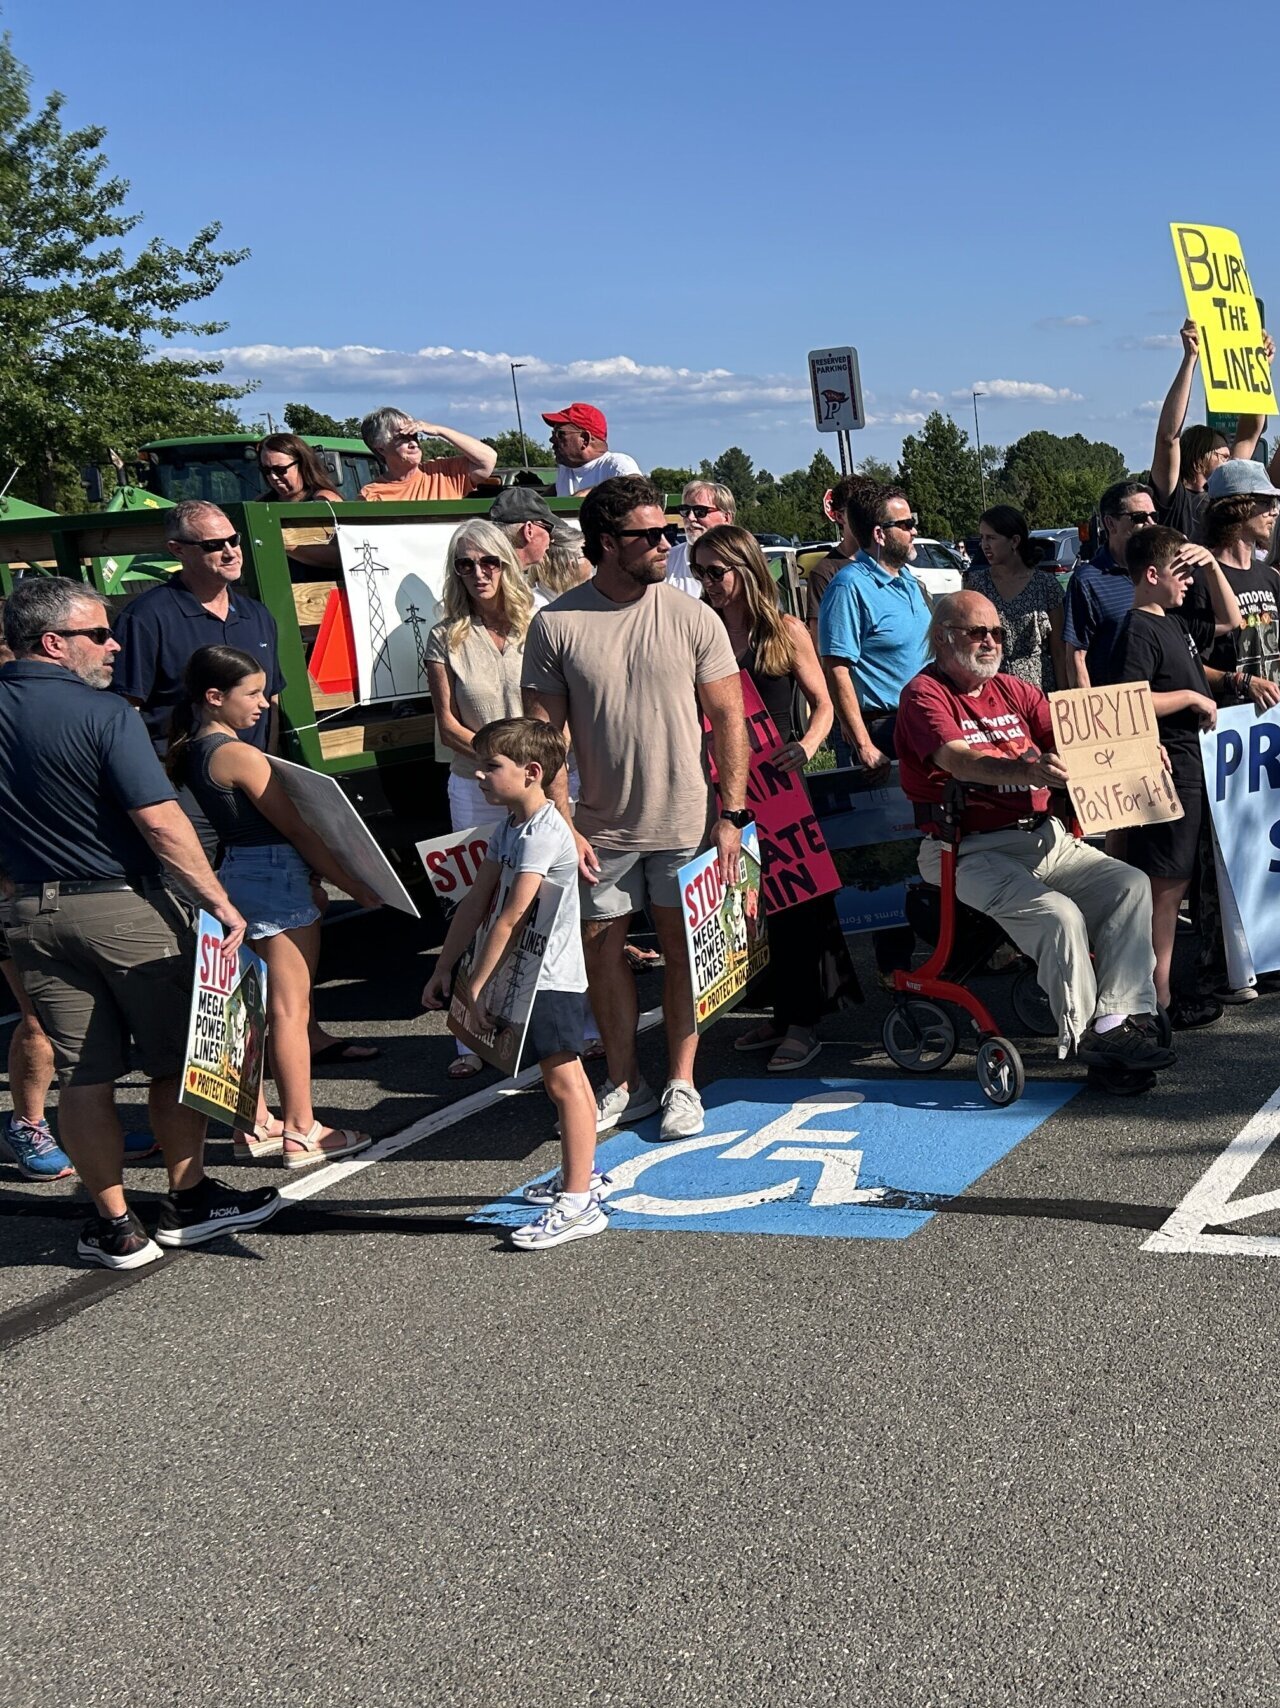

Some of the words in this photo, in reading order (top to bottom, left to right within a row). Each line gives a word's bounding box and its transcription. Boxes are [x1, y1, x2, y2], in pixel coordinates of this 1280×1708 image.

[1177, 227, 1252, 296] BURY
[1212, 297, 1249, 332] THE
[815, 356, 847, 366] RESERVED
[816, 364, 848, 374] PARKING
[1200, 326, 1272, 396] LINES
[426, 838, 491, 893] STO
[684, 857, 726, 929] STOP
[520, 928, 548, 957] LINES
[692, 913, 722, 951] MEGA
[200, 933, 238, 992] STOP
[694, 930, 727, 976] POWER
[698, 951, 727, 993] LINES!
[198, 991, 225, 1018] MEGA
[707, 977, 735, 1012] PROTECT
[195, 1014, 227, 1043] POWER
[194, 1037, 224, 1065] LINES!
[197, 1071, 225, 1103] PROTECT
[209, 1206, 240, 1218] HOKA
